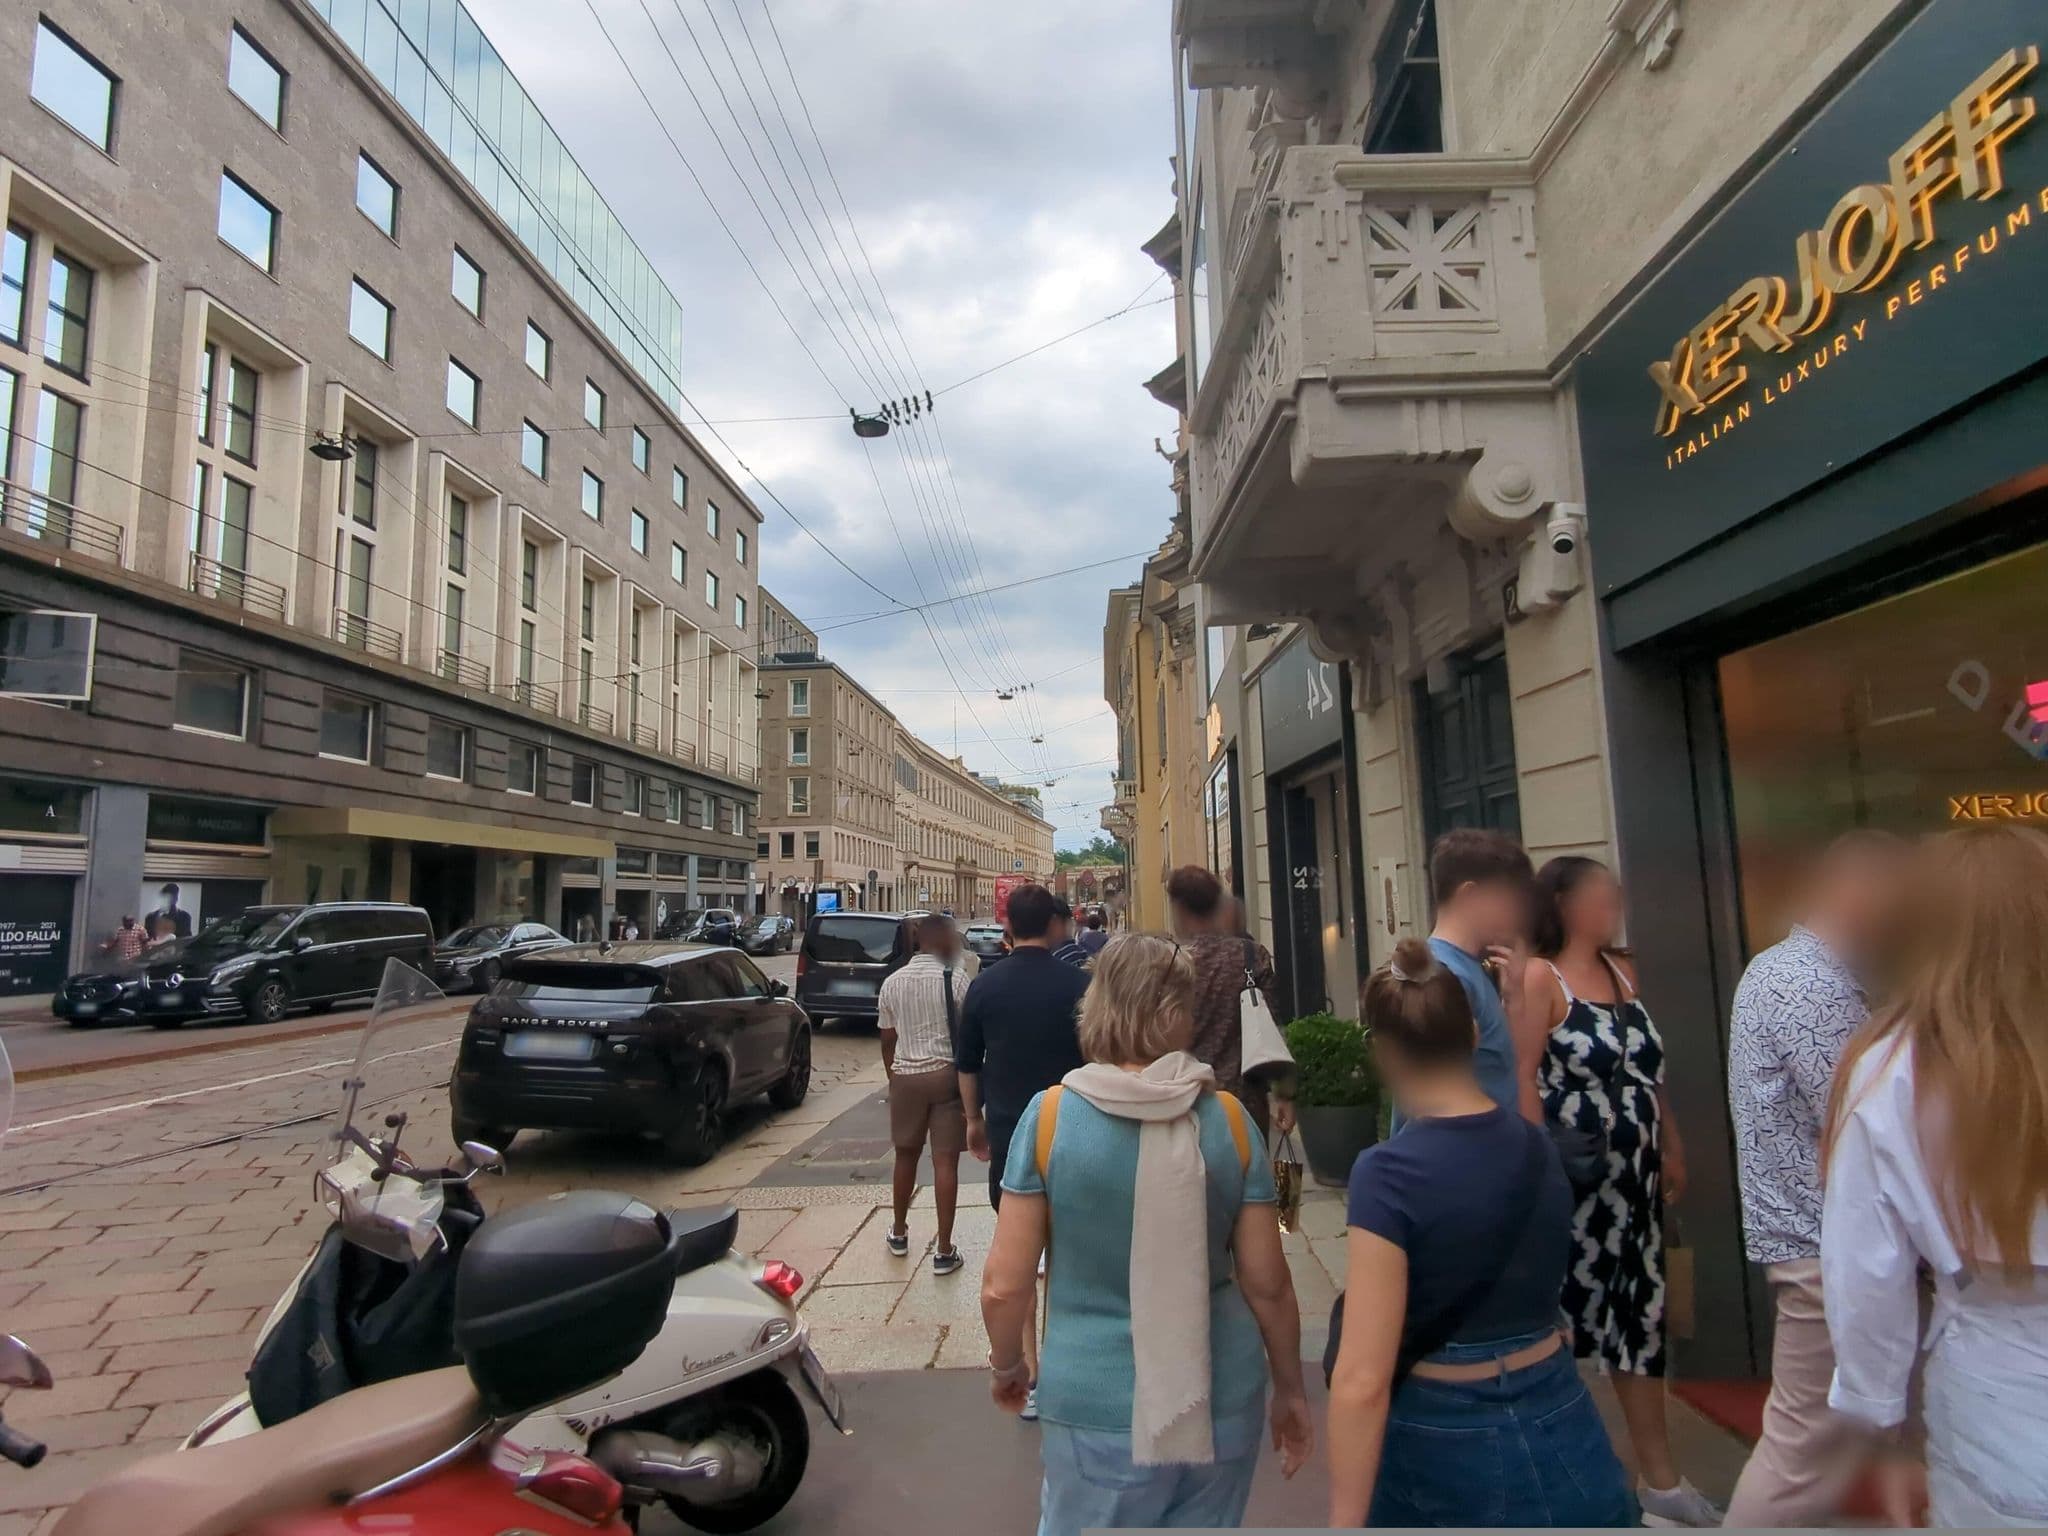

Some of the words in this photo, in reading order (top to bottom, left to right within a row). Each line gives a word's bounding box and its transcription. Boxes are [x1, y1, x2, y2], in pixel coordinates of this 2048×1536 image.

[1648, 44, 2040, 437] XERJOFF
[1666, 402, 1752, 471] ITALIAN
[1764, 318, 1870, 405] LUXURY
[45, 805, 56, 817] A
[26, 930, 61, 941] FALLAI
[557, 1019, 609, 1028] ROVER
